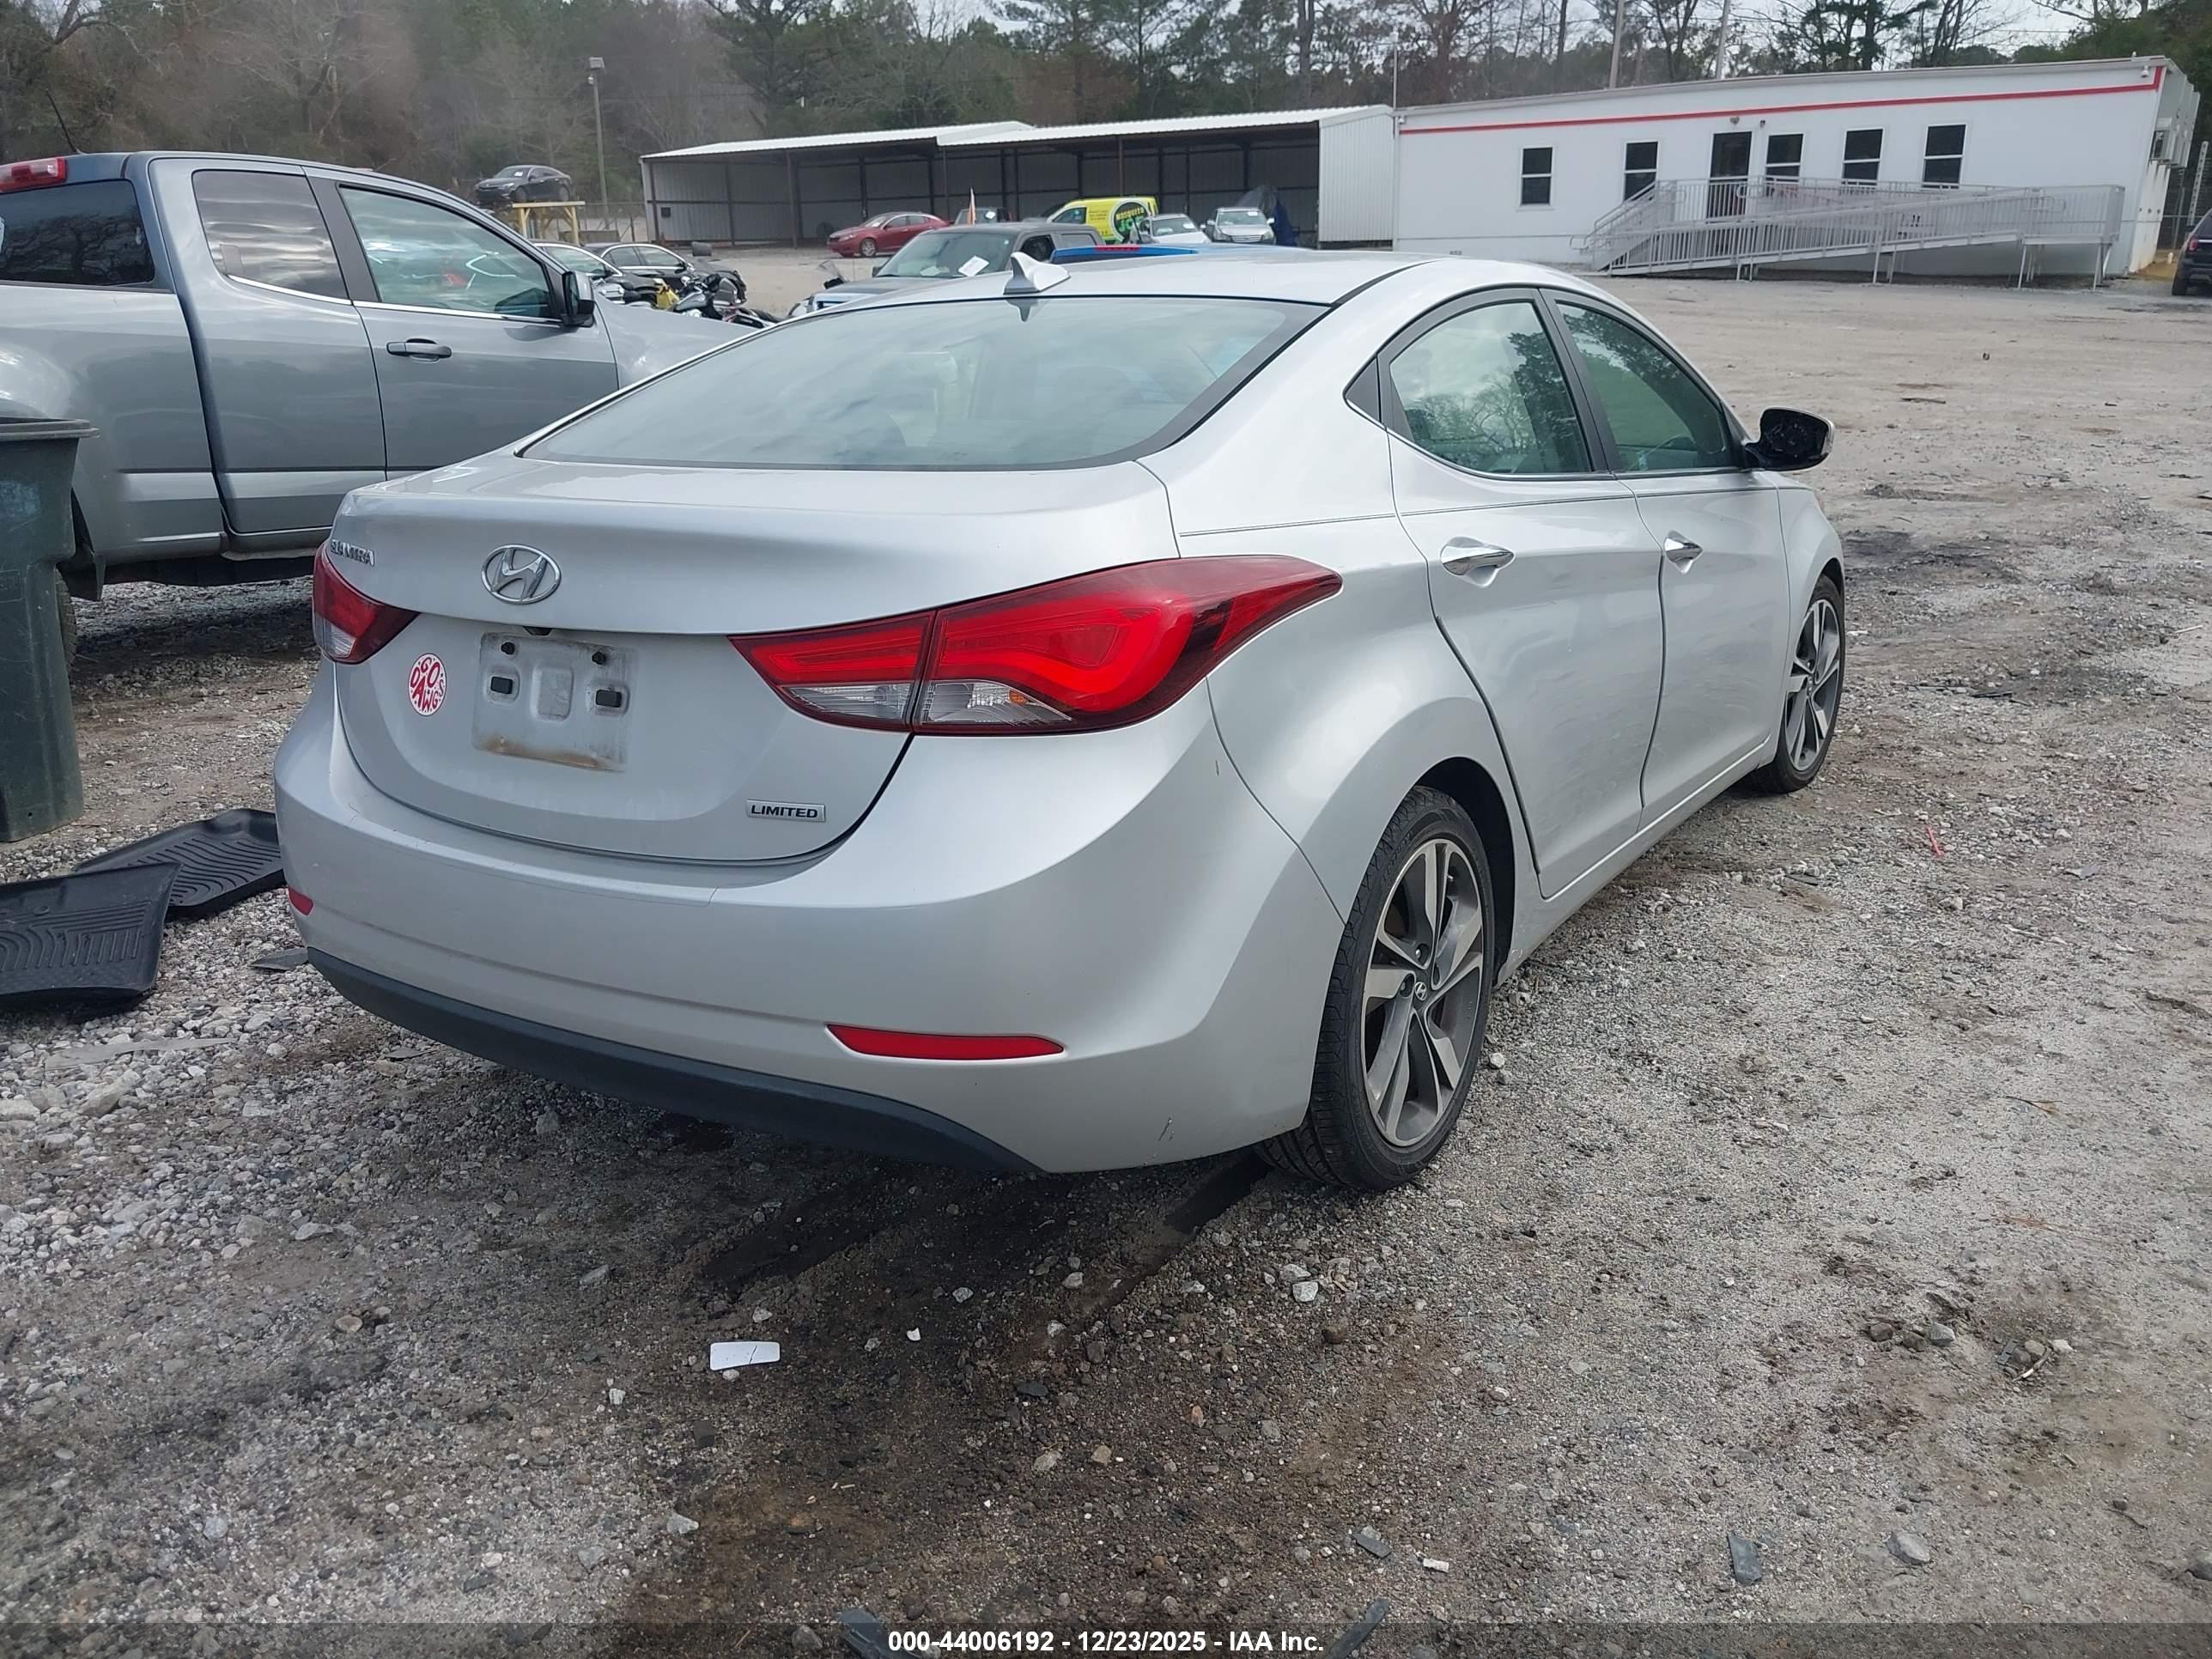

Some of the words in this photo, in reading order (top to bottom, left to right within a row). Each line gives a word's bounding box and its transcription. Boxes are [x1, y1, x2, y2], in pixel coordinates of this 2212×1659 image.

[331, 539, 374, 567] ELANTRA
[420, 656, 441, 689] GO
[750, 805, 818, 818] LIMITED
